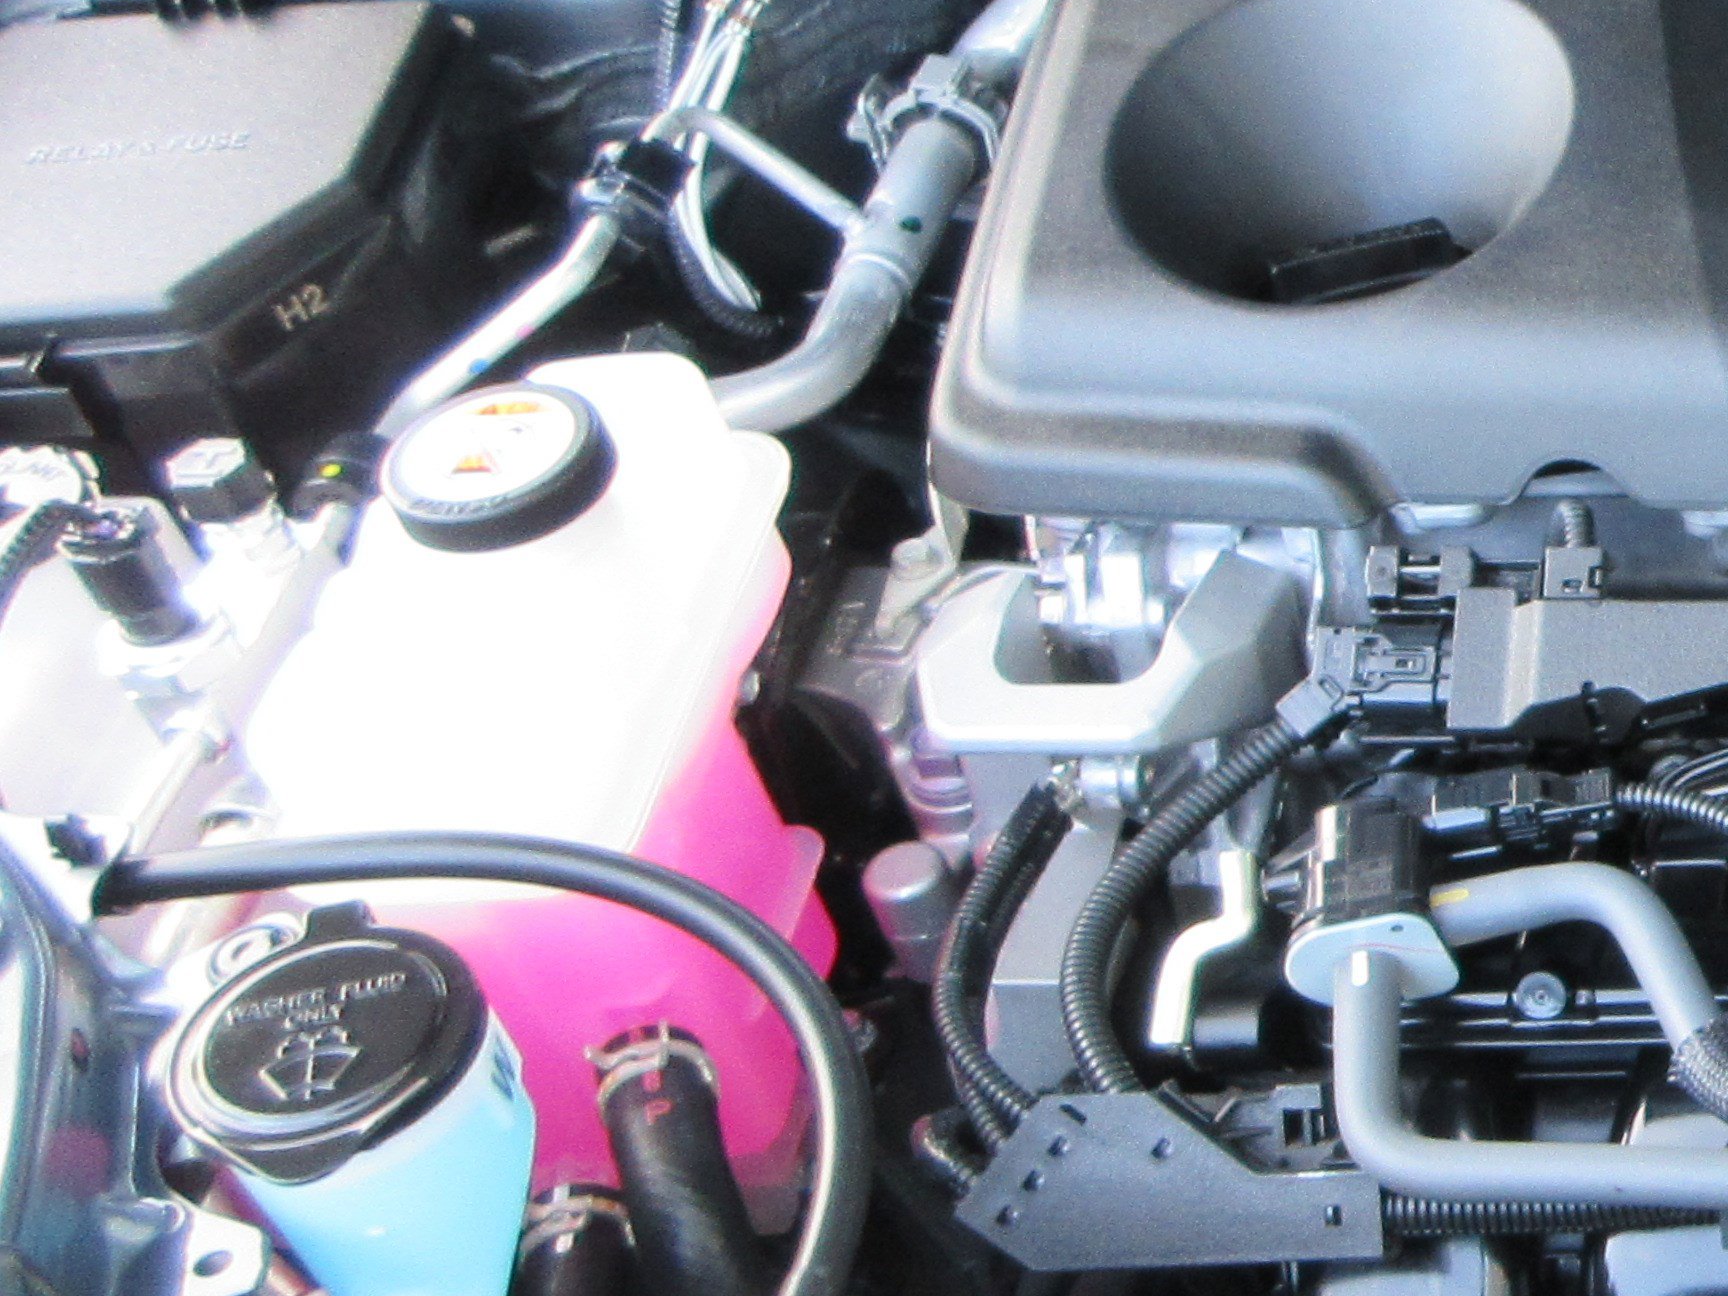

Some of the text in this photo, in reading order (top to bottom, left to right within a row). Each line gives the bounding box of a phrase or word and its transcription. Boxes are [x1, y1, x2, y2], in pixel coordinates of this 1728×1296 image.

[270, 283, 334, 333] H2
[226, 971, 407, 1027] WASHER FLUID
